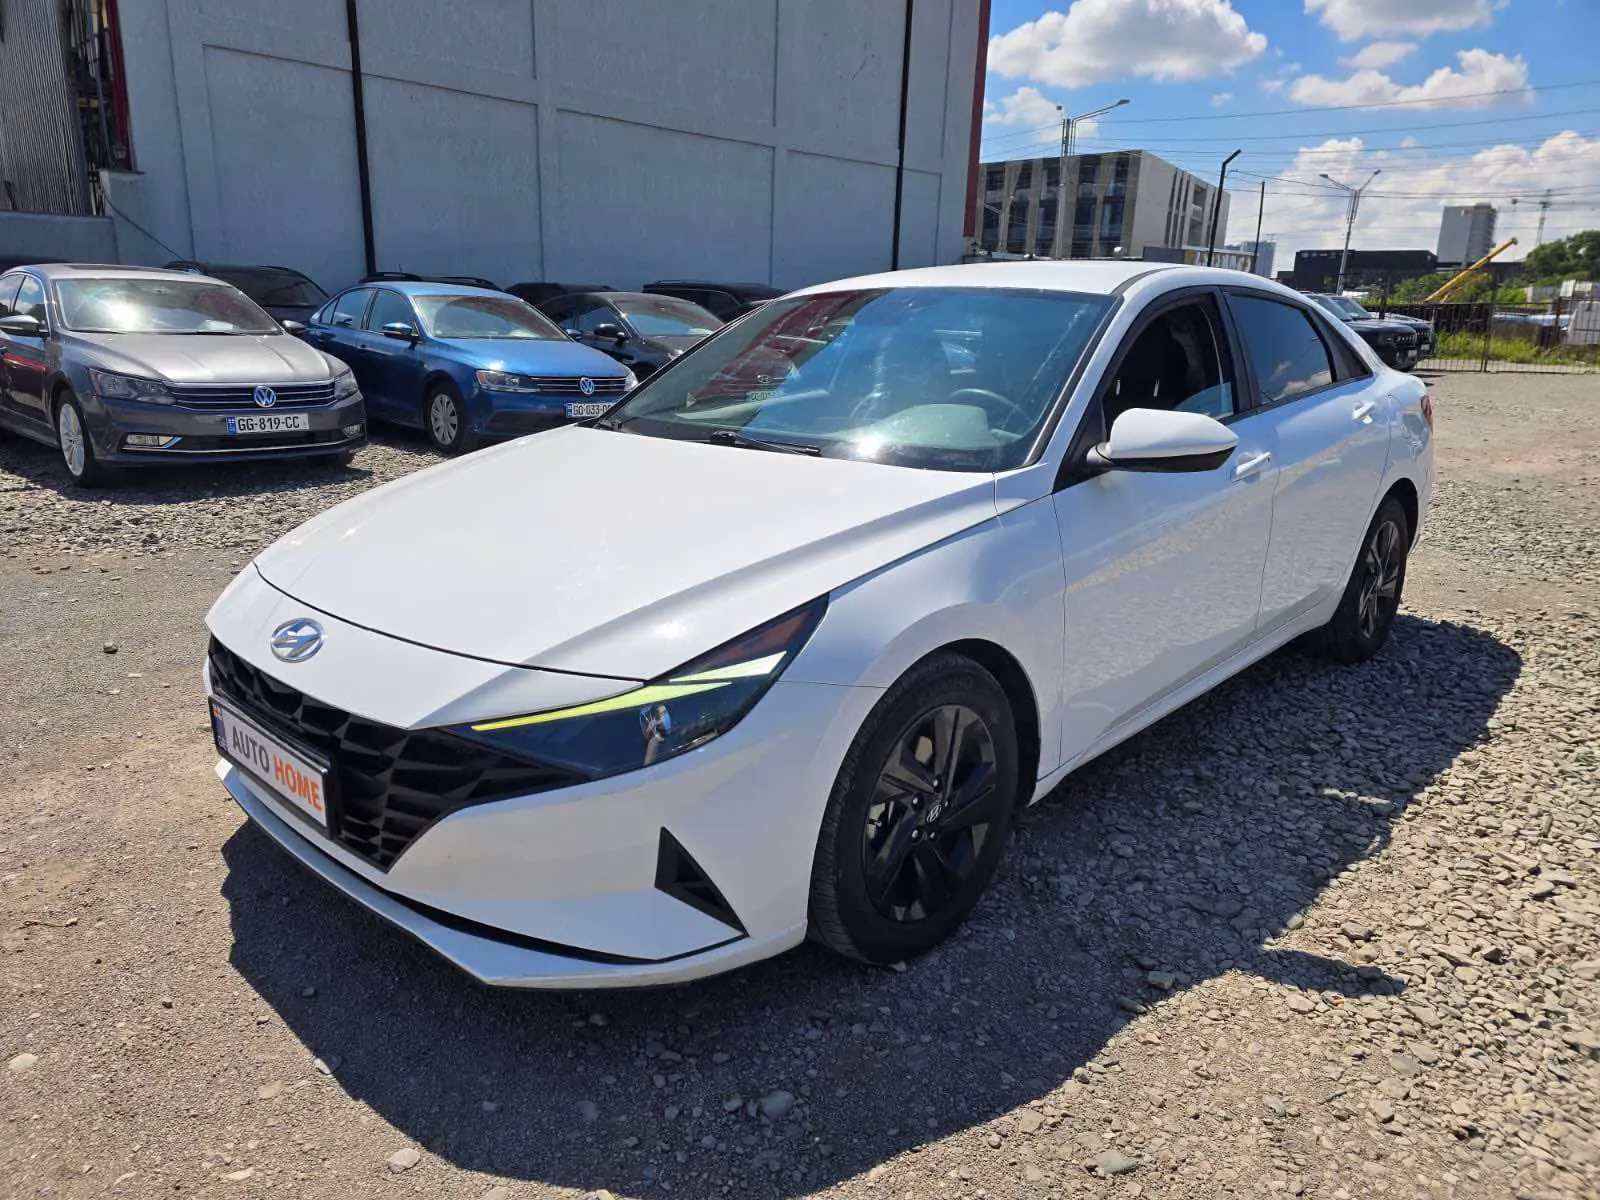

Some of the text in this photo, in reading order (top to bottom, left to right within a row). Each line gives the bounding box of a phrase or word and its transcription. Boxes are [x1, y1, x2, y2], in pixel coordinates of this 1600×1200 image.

[238, 416, 300, 431] GG-819-CC
[232, 726, 323, 812] AUTO HOME
